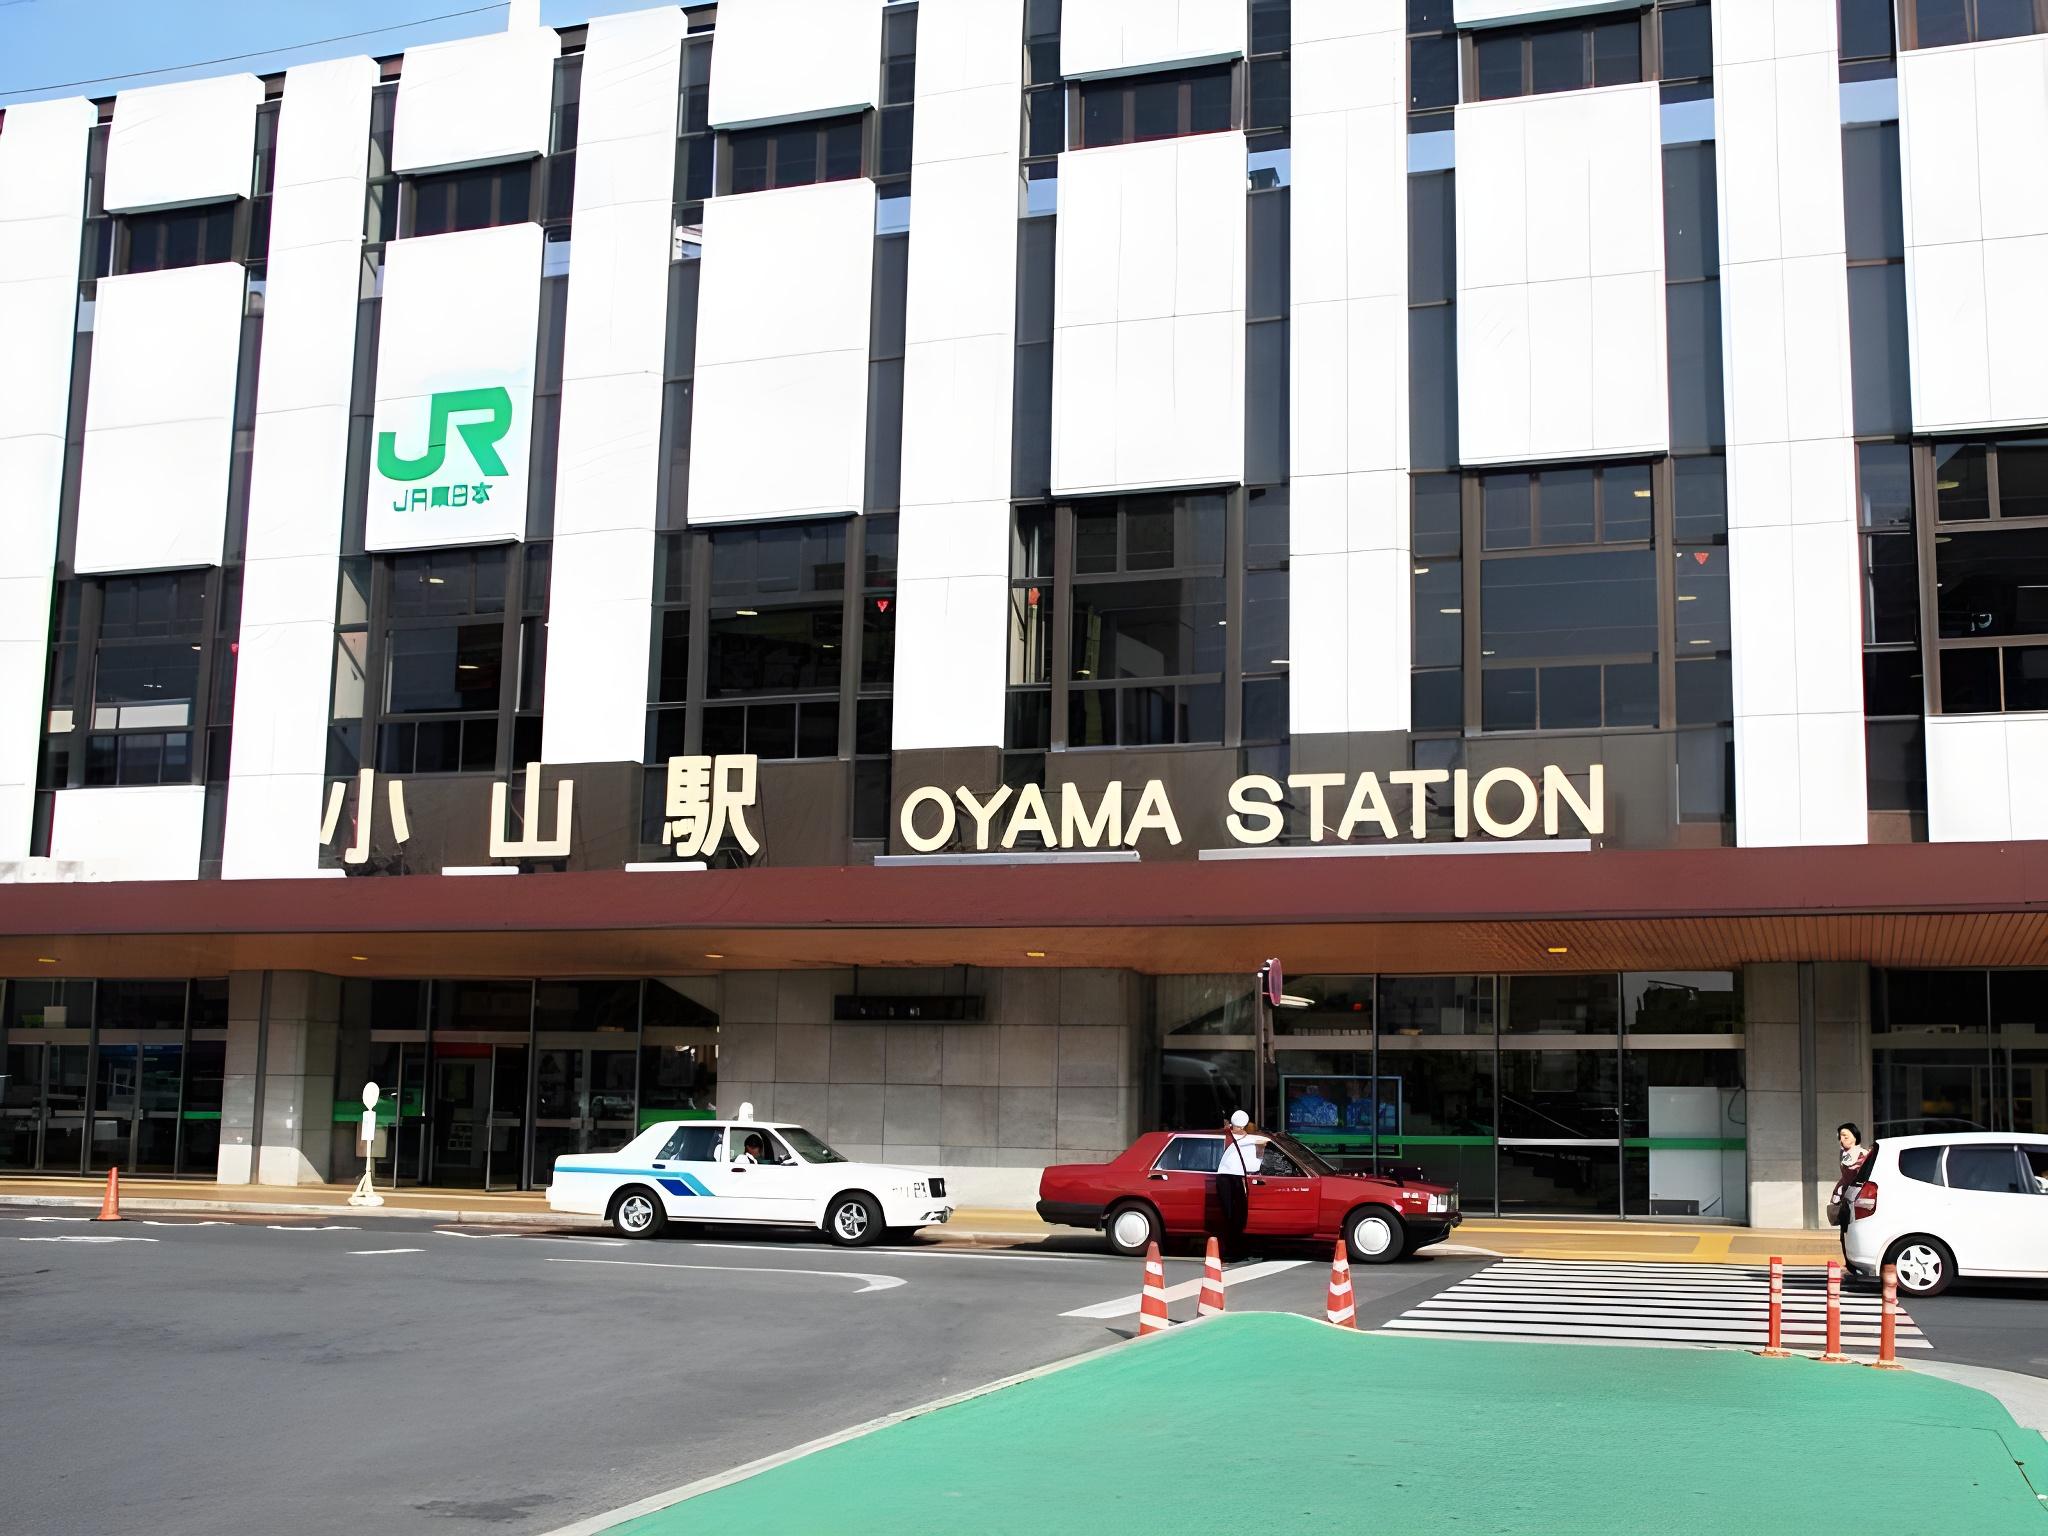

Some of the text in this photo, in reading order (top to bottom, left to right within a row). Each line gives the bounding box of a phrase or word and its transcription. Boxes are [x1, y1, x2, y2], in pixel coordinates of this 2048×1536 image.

[377, 386, 513, 481] JR
[320, 754, 760, 864] 小山駅
[900, 764, 1604, 852] OYAMA STATION
